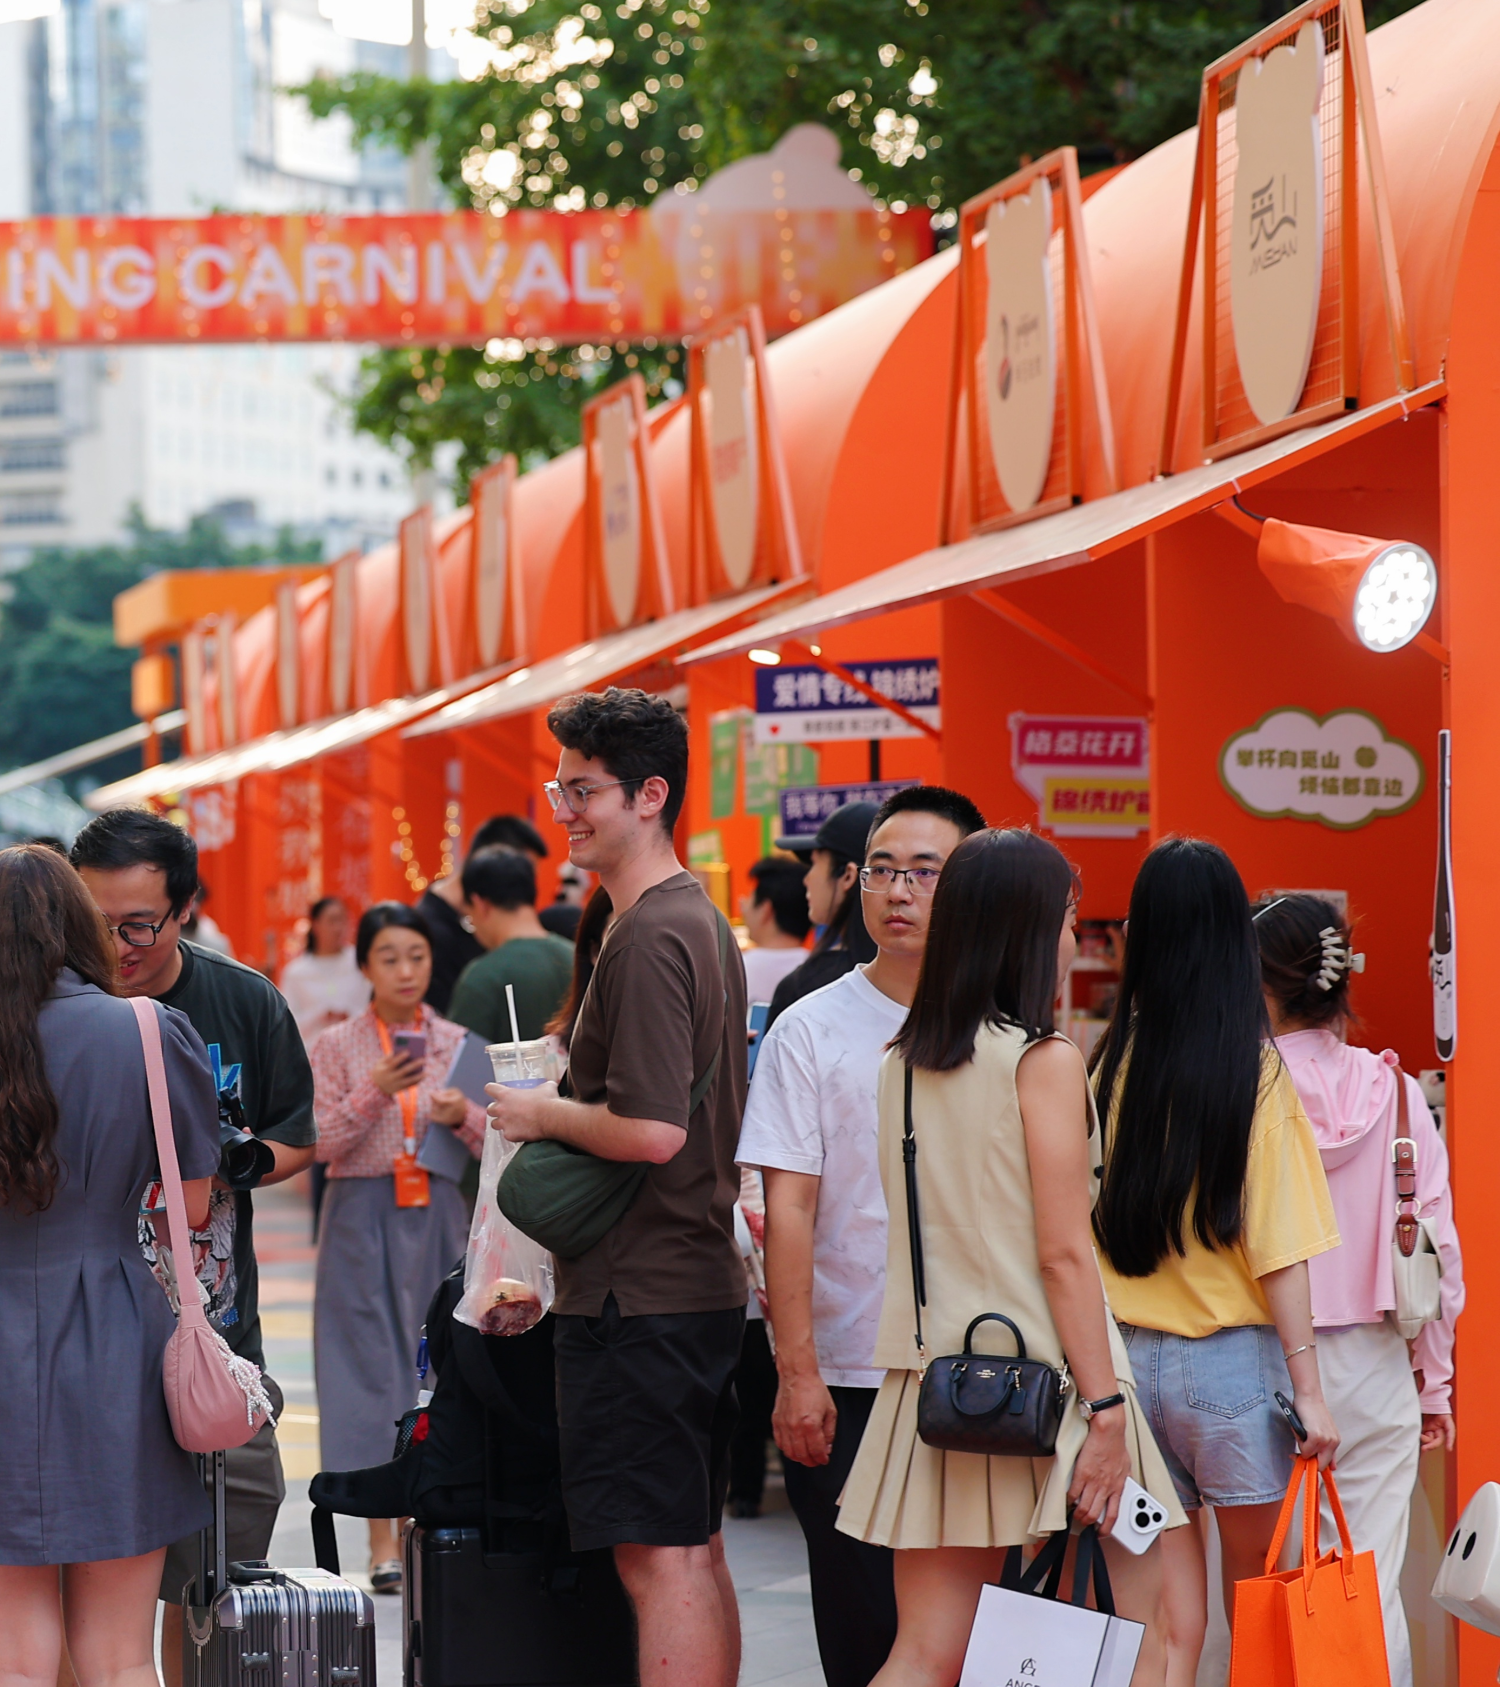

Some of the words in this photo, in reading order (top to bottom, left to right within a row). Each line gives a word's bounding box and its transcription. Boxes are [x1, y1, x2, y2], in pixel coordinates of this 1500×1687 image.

[181, 240, 616, 310] CARNIVAL
[1023, 729, 1135, 757] 格桑花开
